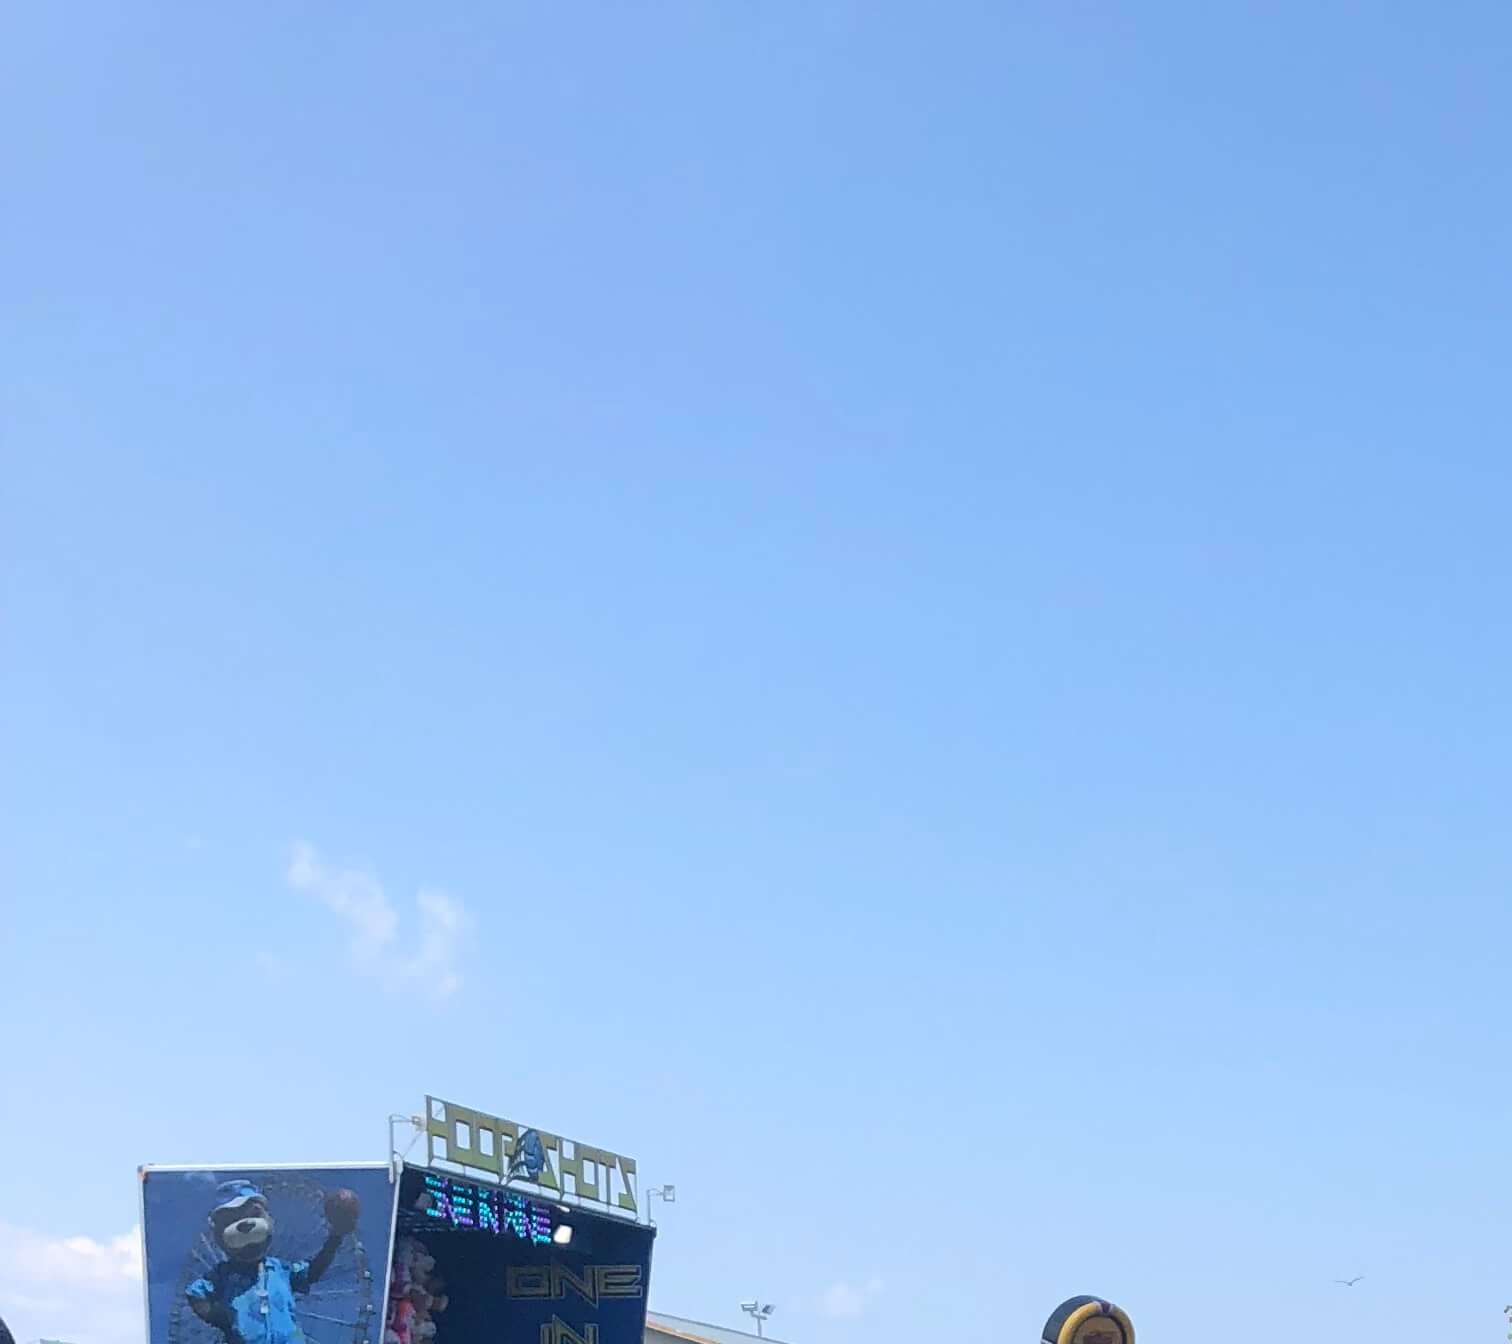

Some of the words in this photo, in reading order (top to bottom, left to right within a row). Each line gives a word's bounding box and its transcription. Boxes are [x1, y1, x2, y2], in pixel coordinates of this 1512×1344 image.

[425, 1095, 520, 1183] HOOP
[537, 1134, 638, 1213] SHOTS
[508, 1264, 643, 1308] ONE
